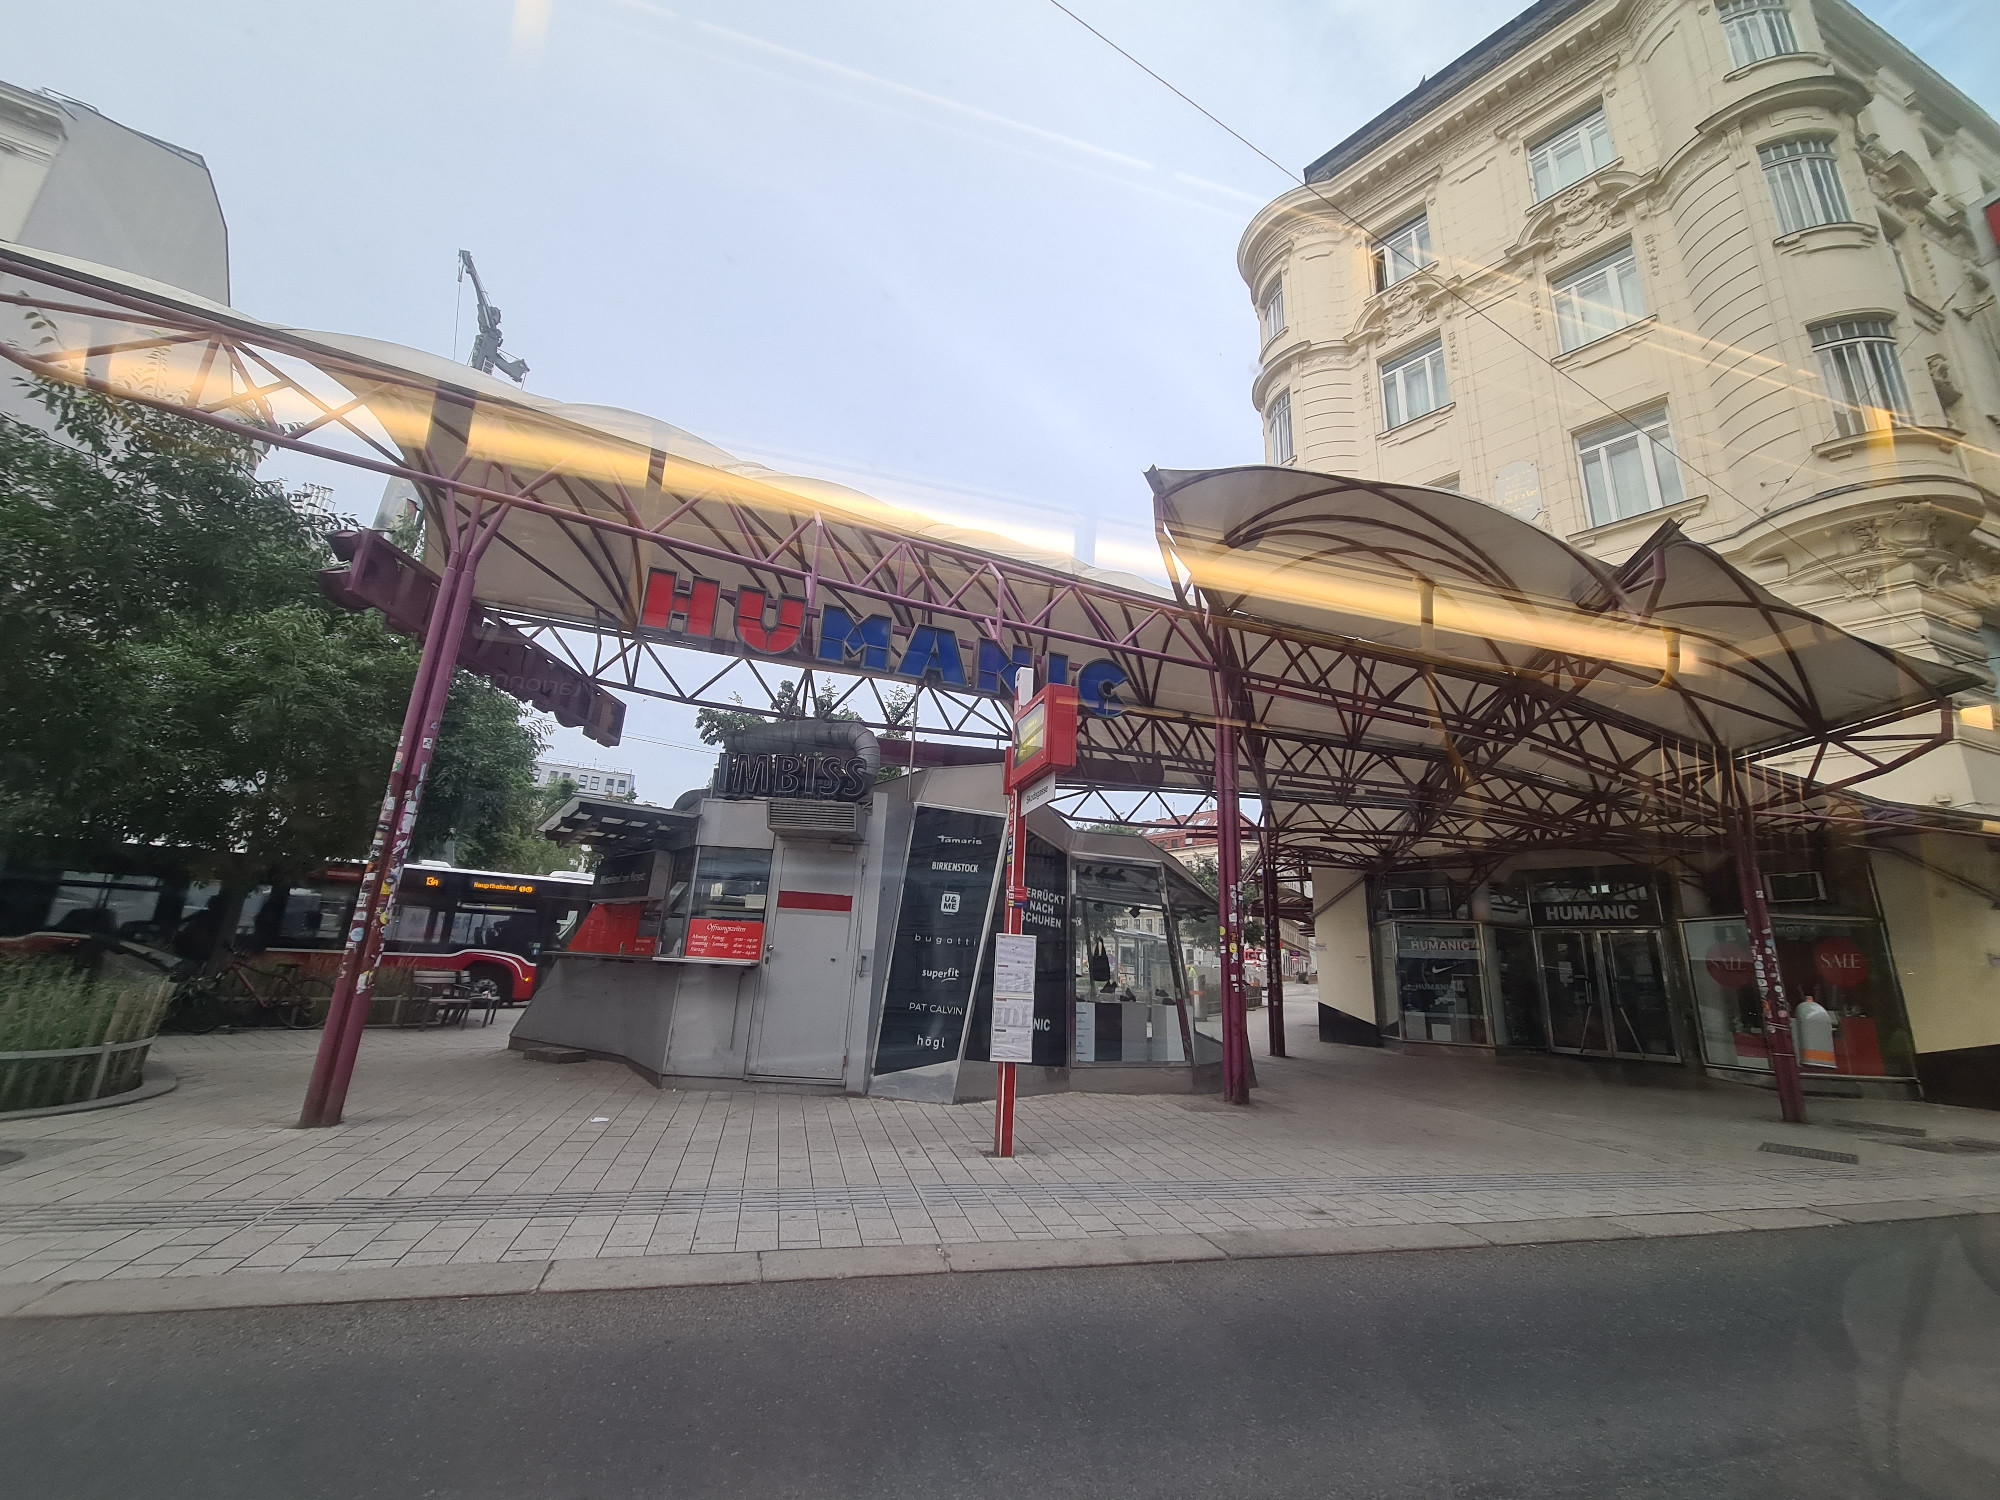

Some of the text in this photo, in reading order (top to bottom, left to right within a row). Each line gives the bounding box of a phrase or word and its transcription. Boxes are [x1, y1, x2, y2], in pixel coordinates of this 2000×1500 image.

[640, 567, 1130, 718] HUMANIC
[717, 752, 868, 800] IMBISS
[937, 835, 983, 845] Tamaris
[932, 861, 979, 873] BIRKENSTOCK
[426, 876, 439, 887] 13A
[473, 881, 518, 892] Hauptbahnhof
[1026, 887, 1066, 906] ERRÜCKT
[943, 902, 957, 910] ME
[1030, 901, 1054, 915] NACH
[1545, 903, 1640, 921] HUMANIC
[1022, 911, 1062, 929] SCHUHEN
[915, 933, 978, 946] bugatti
[1411, 940, 1471, 951] HUMANIC
[1820, 953, 1862, 969] SALE
[922, 968, 960, 980] superfit
[909, 1002, 963, 1016] PAT CALVIN
[917, 1034, 946, 1050] högl
